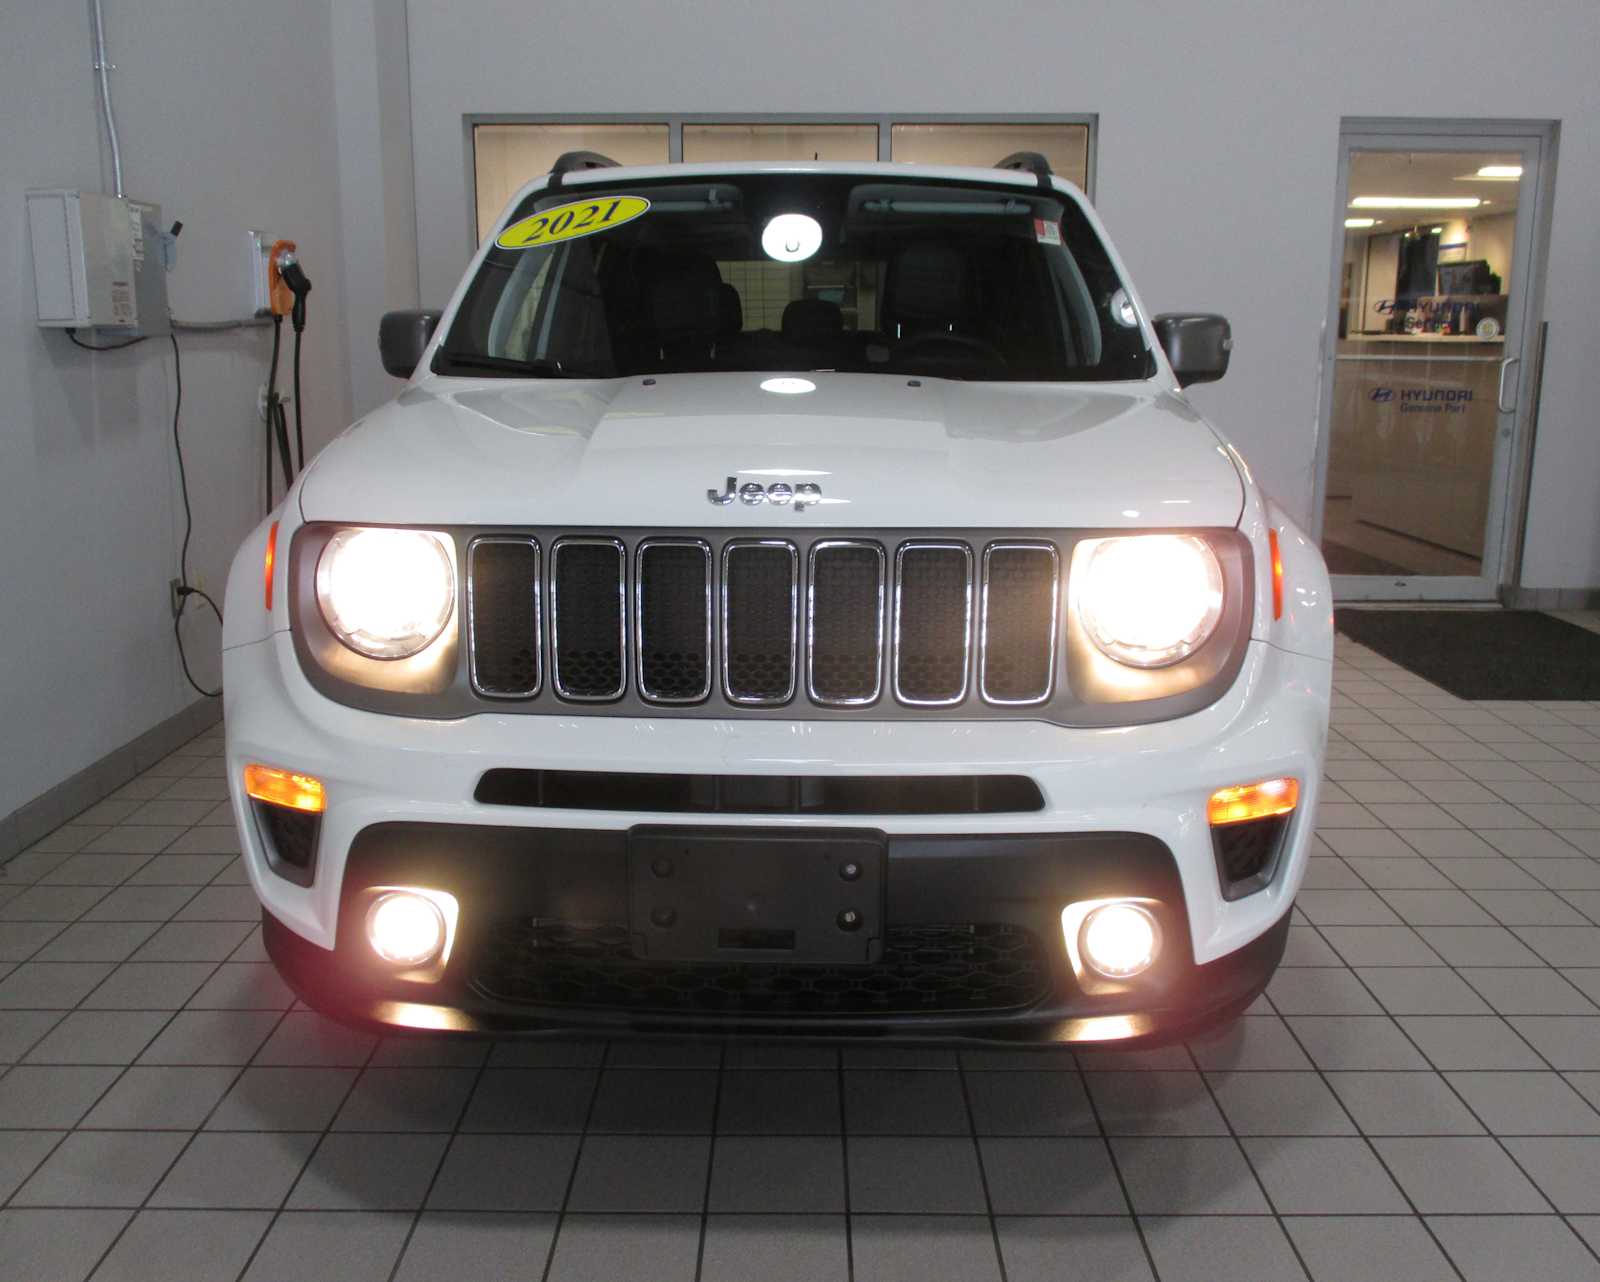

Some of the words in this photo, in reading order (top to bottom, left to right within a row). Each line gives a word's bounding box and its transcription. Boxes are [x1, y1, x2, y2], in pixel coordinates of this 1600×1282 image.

[523, 199, 622, 243] 2021
[1400, 389, 1473, 401] HYUNDAI
[706, 476, 822, 512] Jeep
